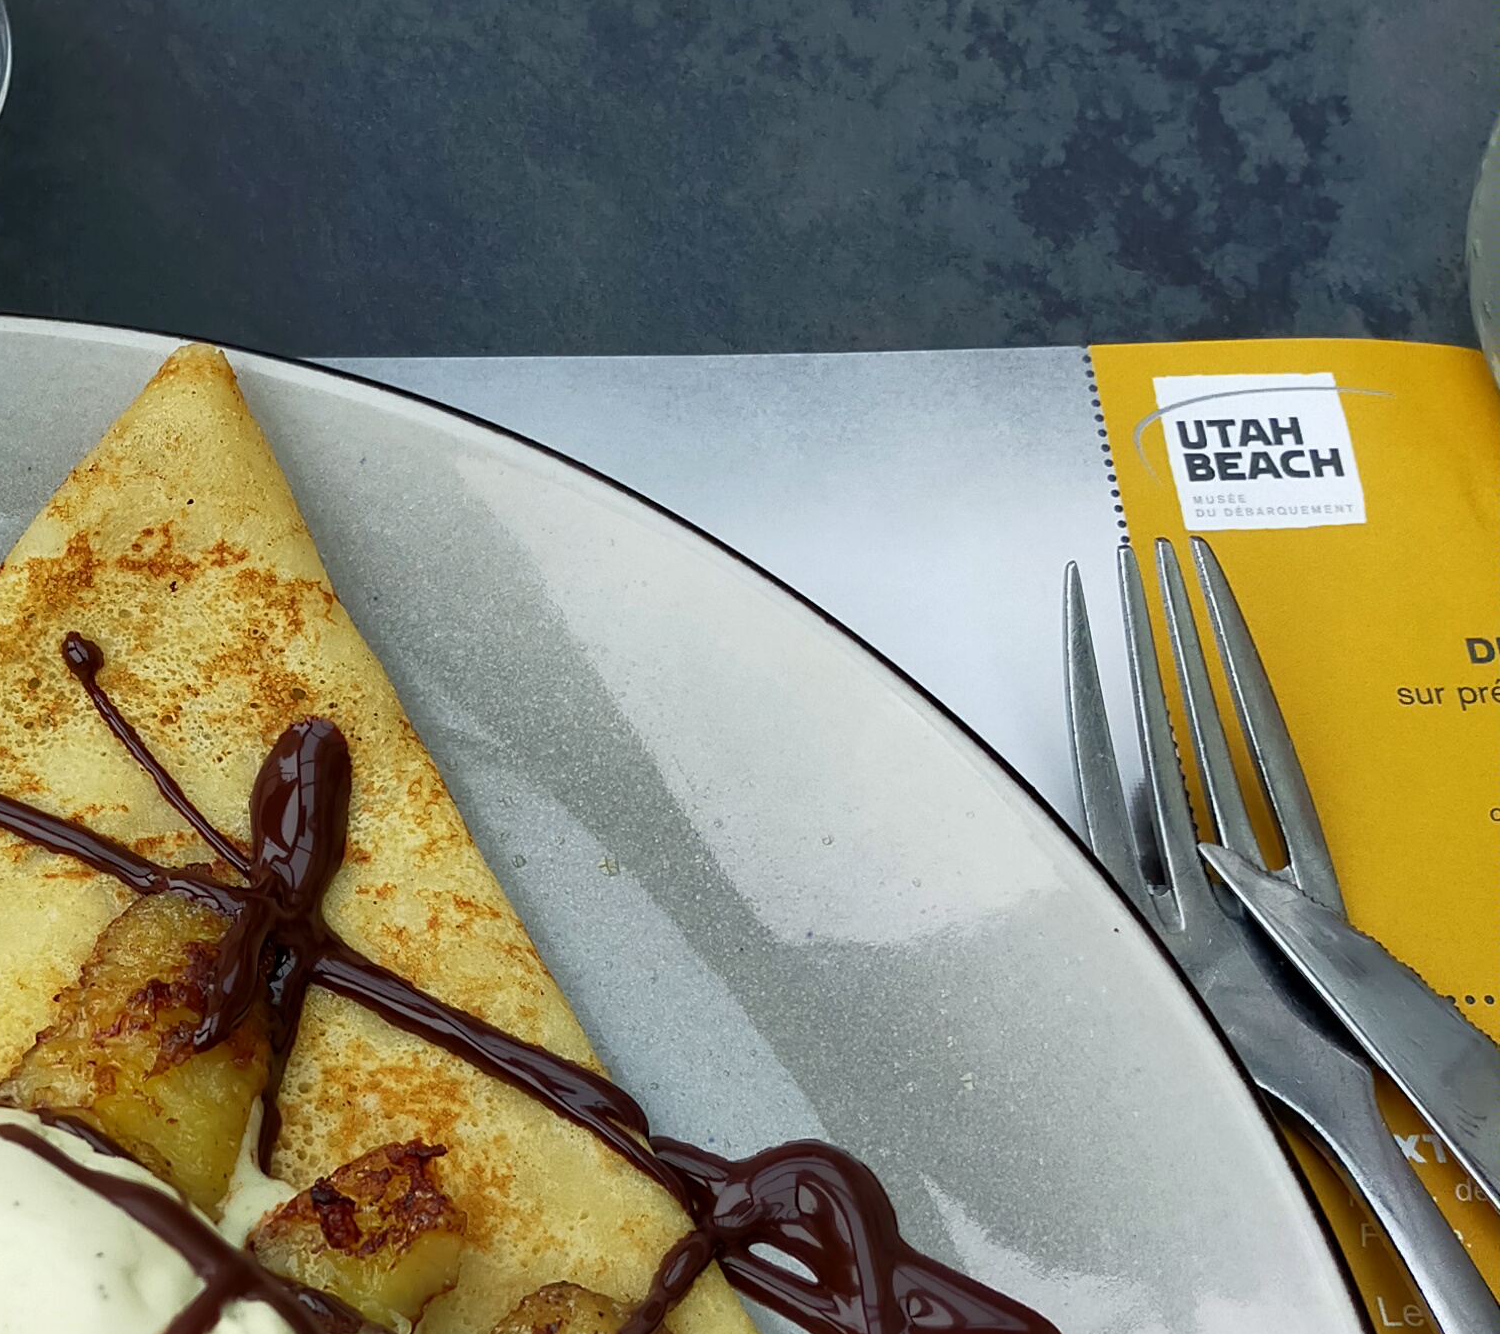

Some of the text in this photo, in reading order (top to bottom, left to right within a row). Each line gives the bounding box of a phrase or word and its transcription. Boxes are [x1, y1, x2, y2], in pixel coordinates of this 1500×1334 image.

[1176, 416, 1304, 450] UTAH
[1183, 447, 1345, 482] BEACH
[1192, 493, 1247, 505] MUSÉE
[1195, 503, 1354, 518] DU DÉBARQUEMENT
[1396, 686, 1445, 705] sur
